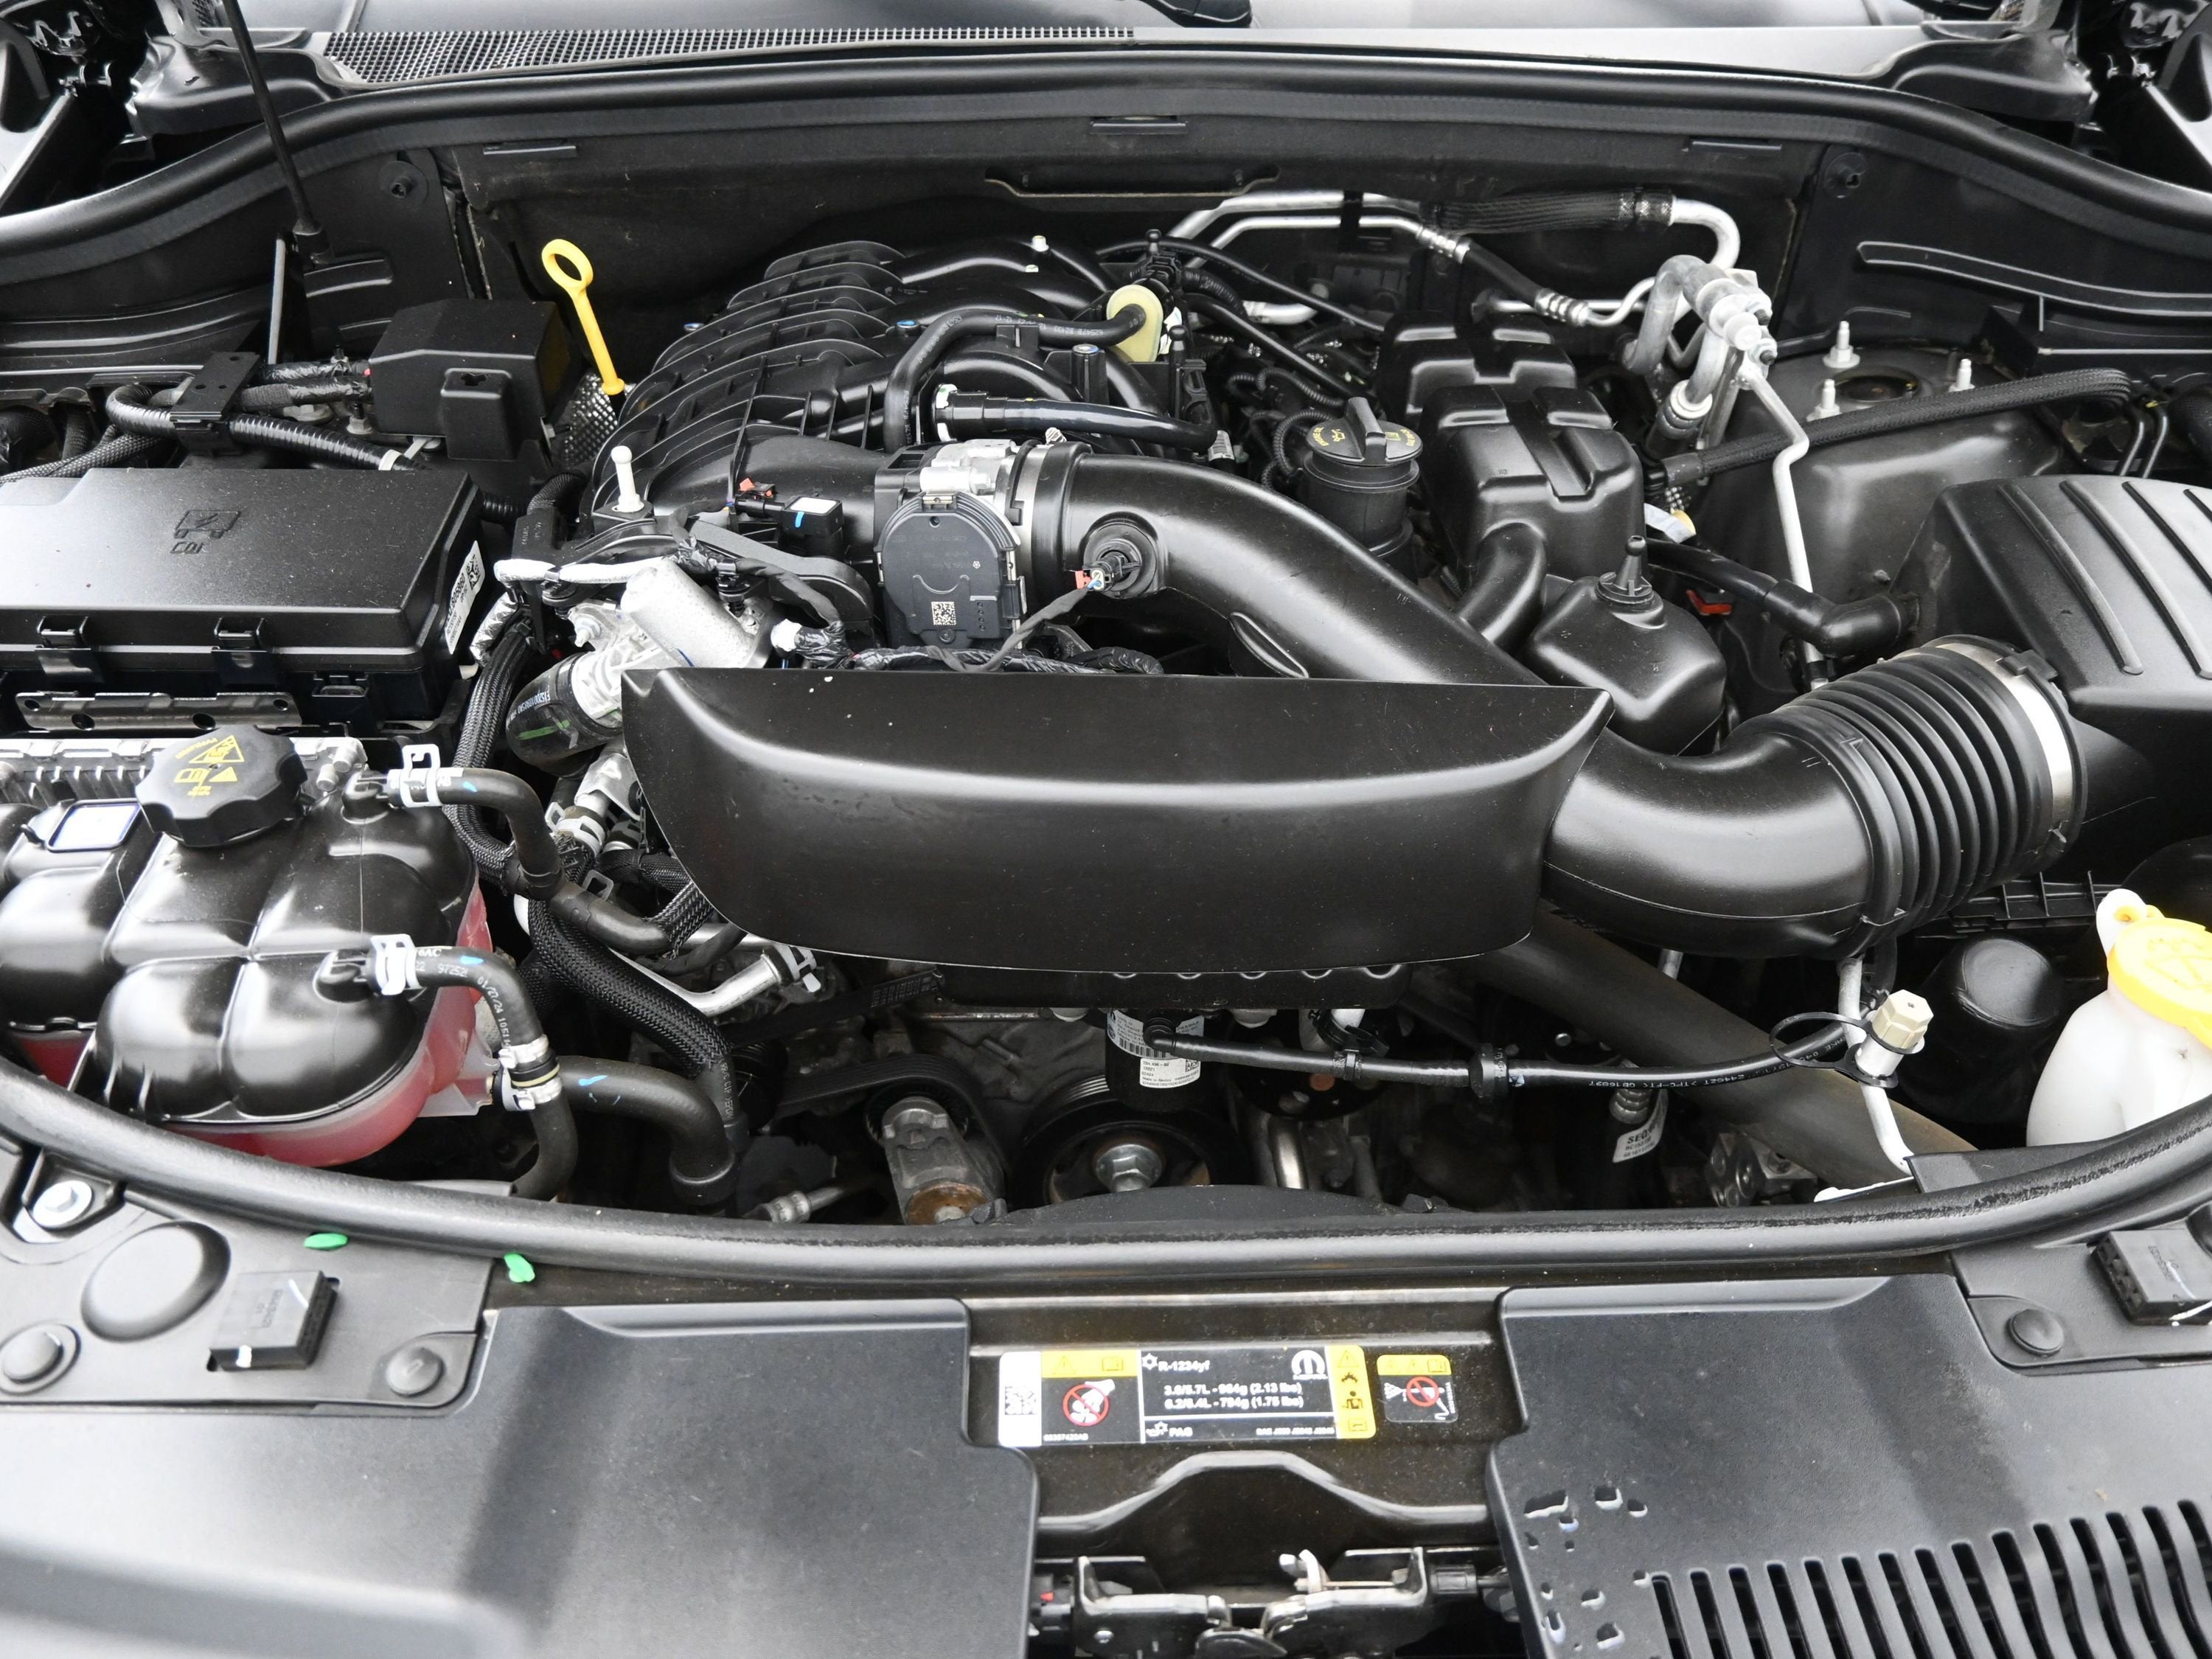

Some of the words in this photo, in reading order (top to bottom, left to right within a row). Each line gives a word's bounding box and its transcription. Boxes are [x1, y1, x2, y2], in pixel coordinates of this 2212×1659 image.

[1158, 1360, 1211, 1372] R-1234yf
[1250, 1382, 1278, 1394] (2.13
[1169, 1427, 1193, 1437] PAG
